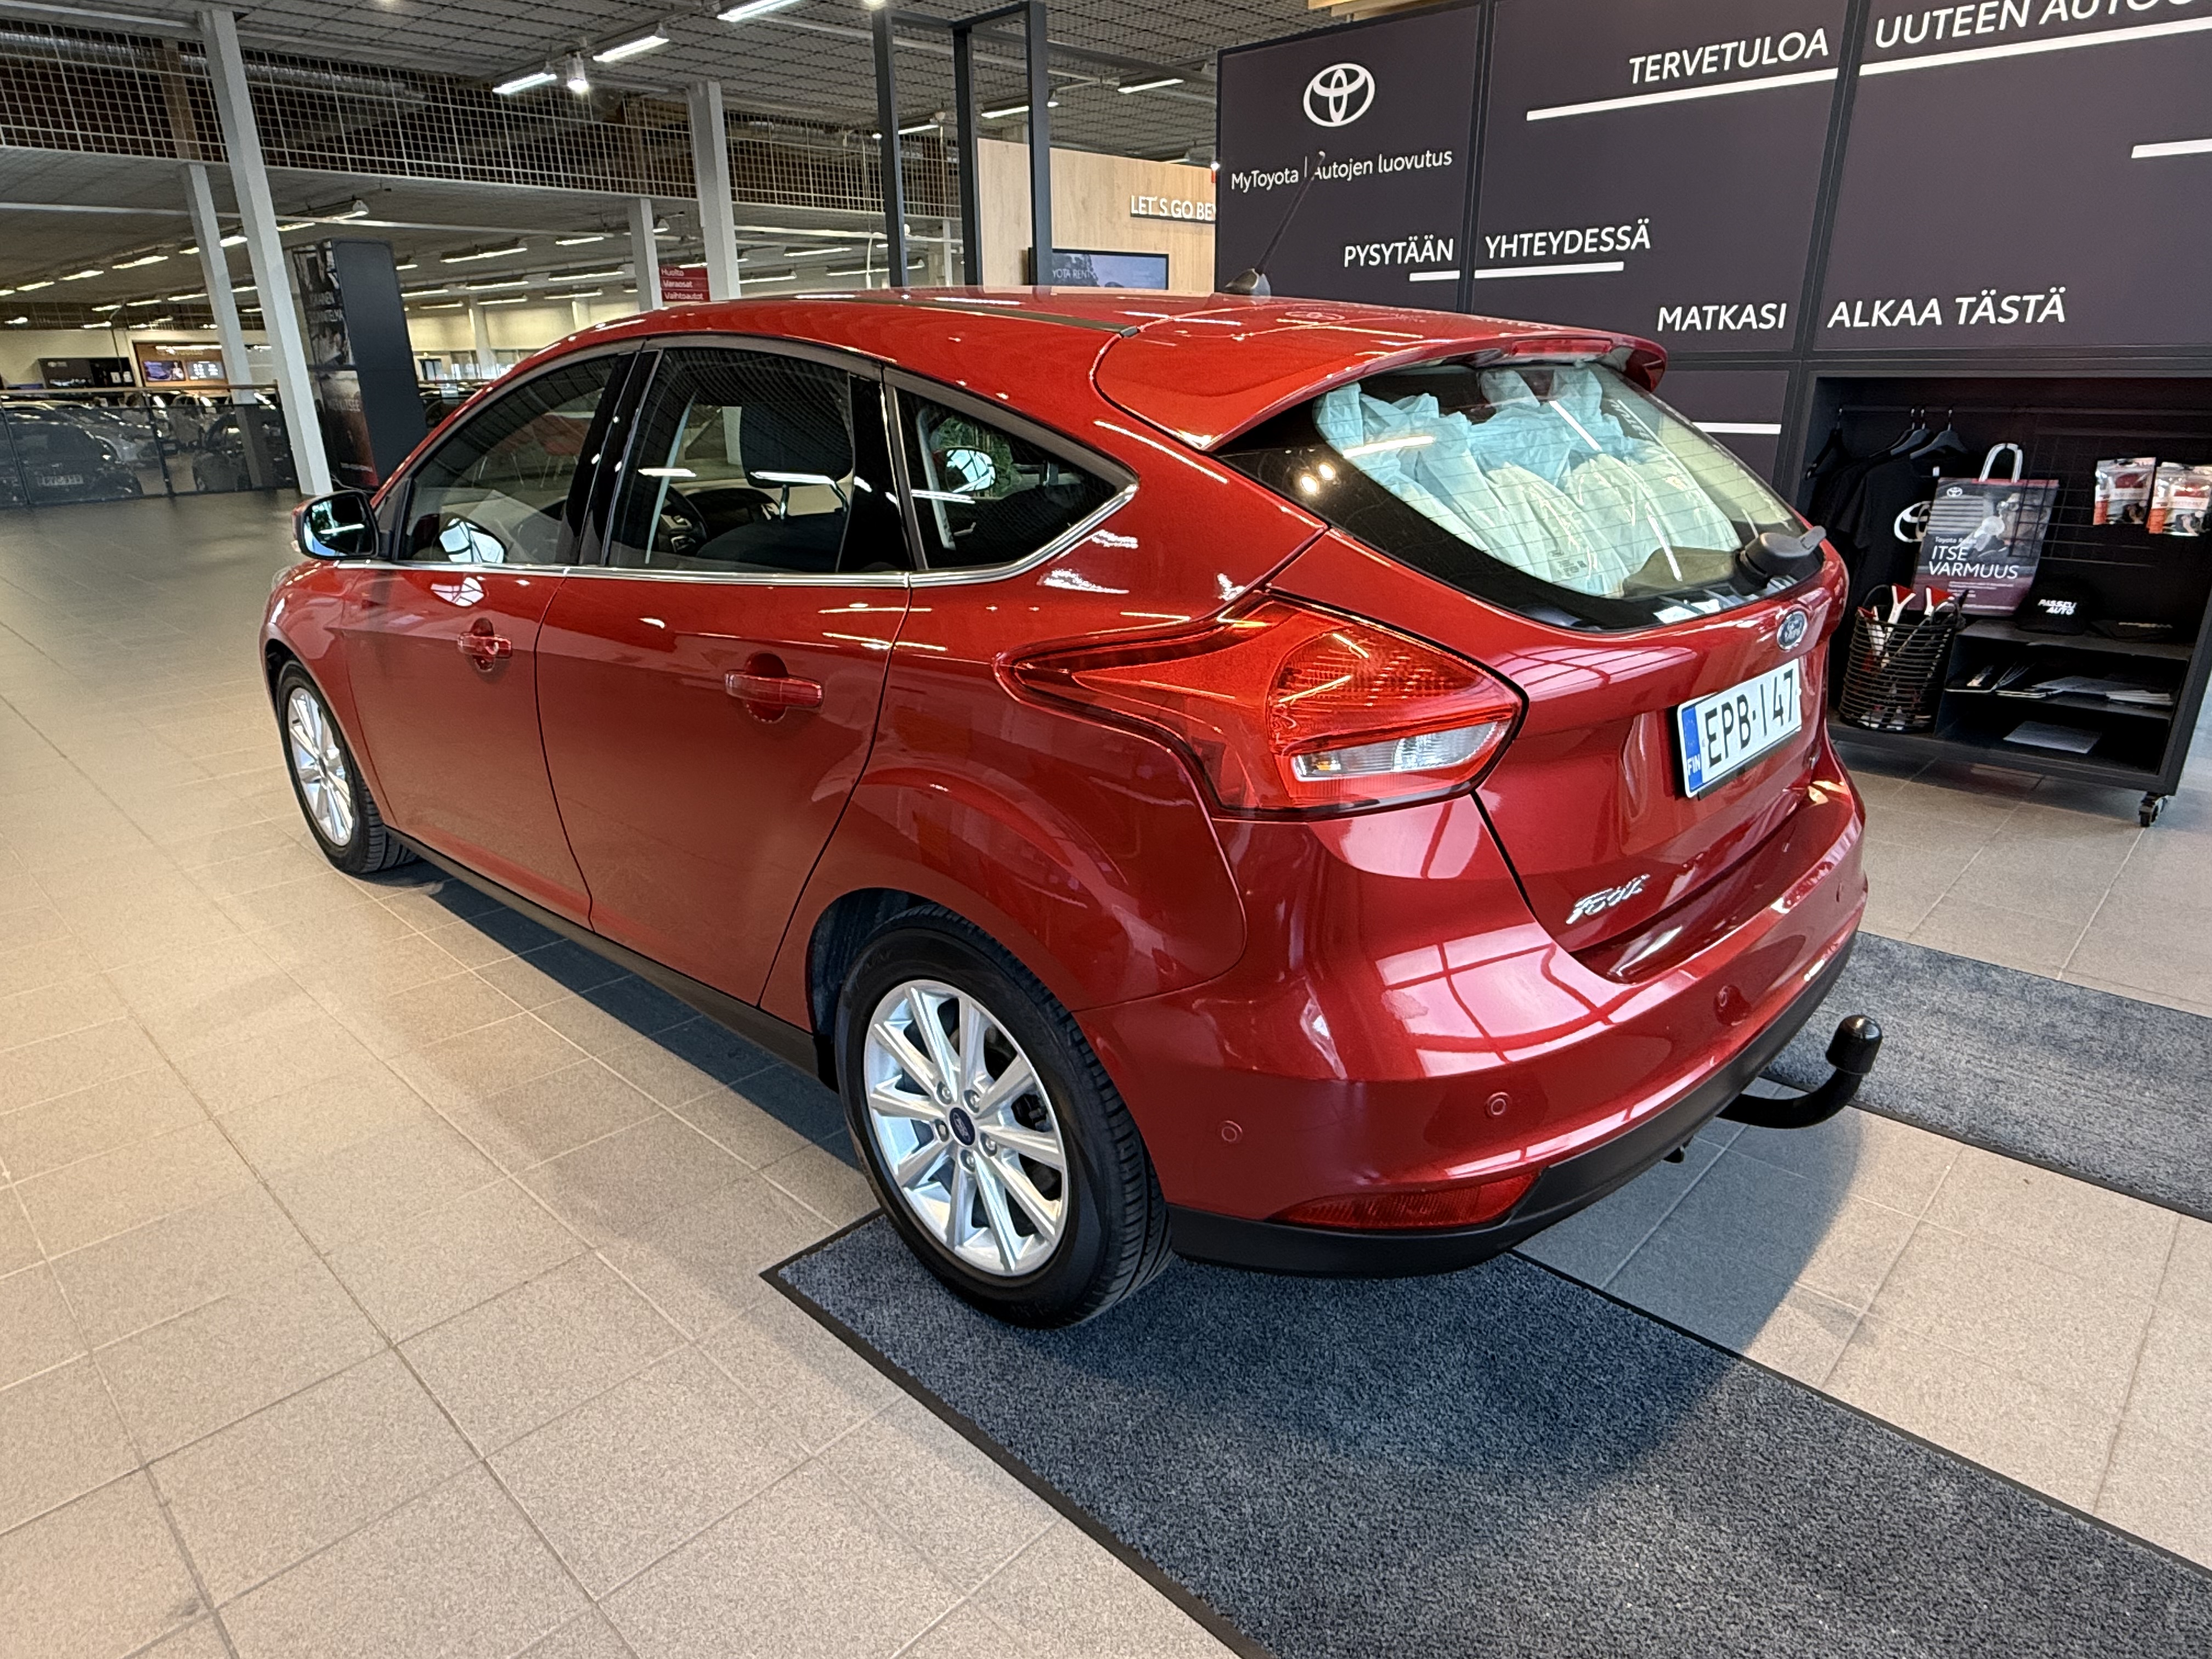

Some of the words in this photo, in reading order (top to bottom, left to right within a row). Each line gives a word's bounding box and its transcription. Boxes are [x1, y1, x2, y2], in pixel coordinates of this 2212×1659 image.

[1629, 27, 1830, 83] TERVETULOA
[1875, 0, 2031, 48] UUTEEN
[1231, 168, 1299, 193] MyToyota
[1312, 157, 1373, 181] Autojen
[1378, 150, 1453, 173] luovutus
[1171, 200, 1193, 218] GO
[1344, 234, 1454, 267] PYSYTÄÄN
[1485, 218, 1651, 259] YHTEYDESSÄ
[1657, 303, 1787, 331] MATKASI
[1827, 298, 1942, 328] ALKAA
[1955, 286, 2066, 325] TÄSTÄ
[1928, 560, 2020, 579] VARMUUS
[1931, 545, 1969, 561] ITSE
[1687, 753, 1701, 776] FIN
[1704, 668, 1794, 769] EPB-147
